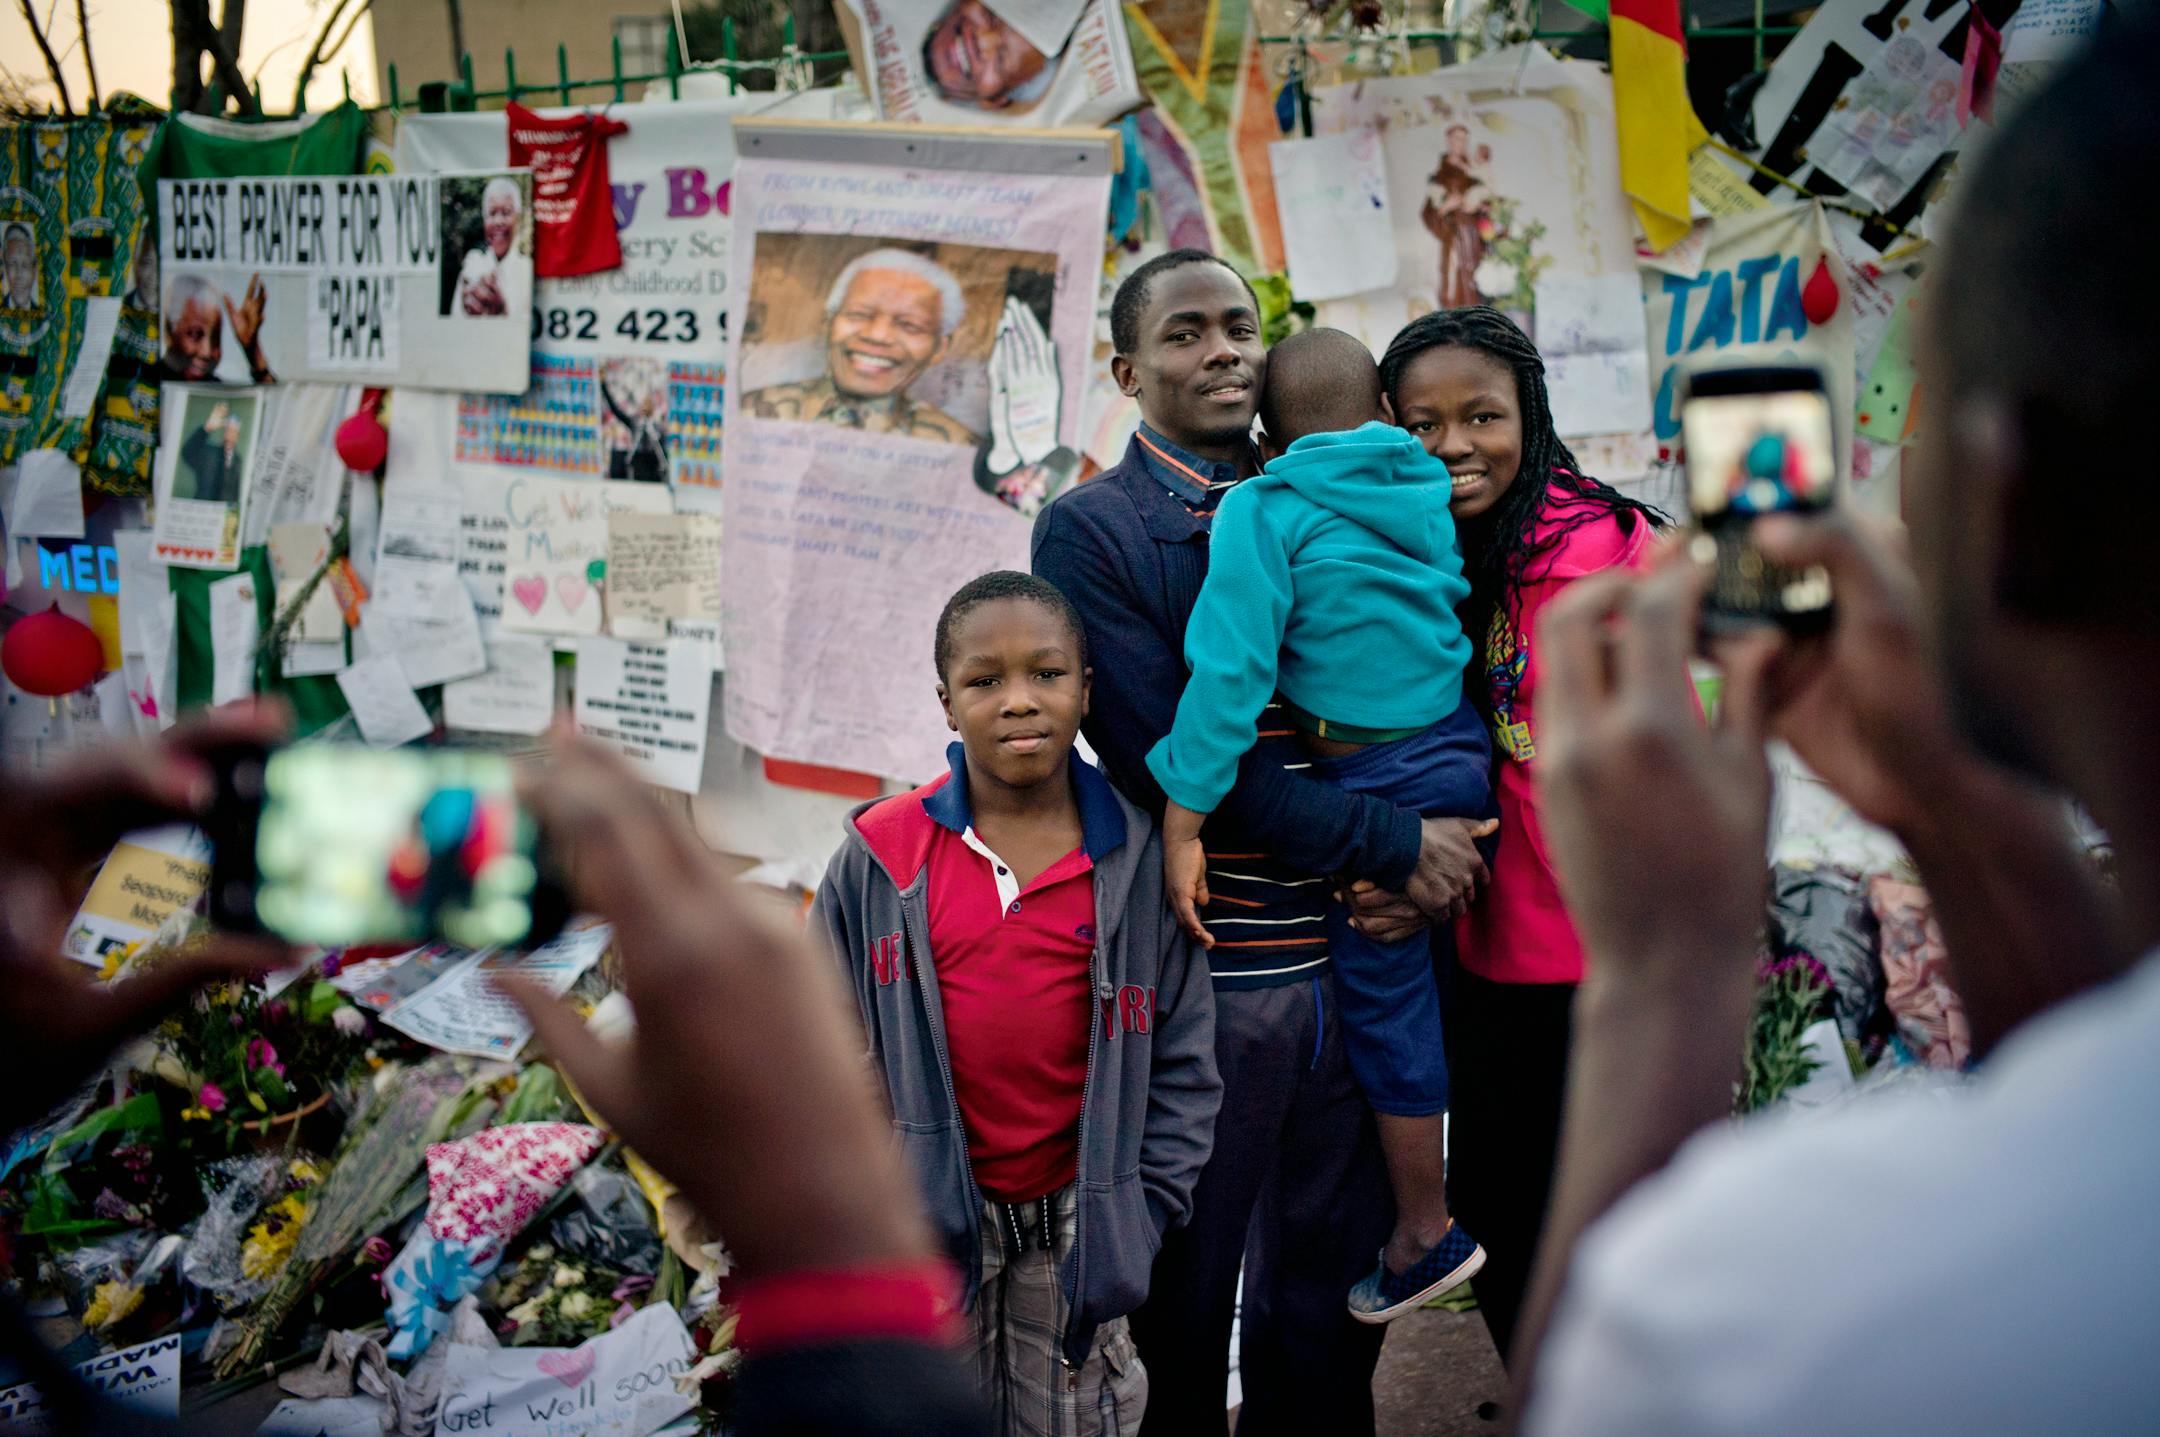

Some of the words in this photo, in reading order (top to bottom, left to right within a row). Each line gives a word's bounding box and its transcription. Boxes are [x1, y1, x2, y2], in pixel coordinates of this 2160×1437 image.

[173, 183, 229, 260] BEST
[240, 181, 327, 263] PRAYER
[338, 182, 383, 263] FOR
[393, 178, 439, 263] YOU
[609, 270, 702, 295] Childhood
[616, 308, 699, 342] 423
[1663, 253, 1808, 356] TATA
[38, 545, 119, 594] MED
[79, 1333, 180, 1376] MADI
[441, 1391, 498, 1433] Get
